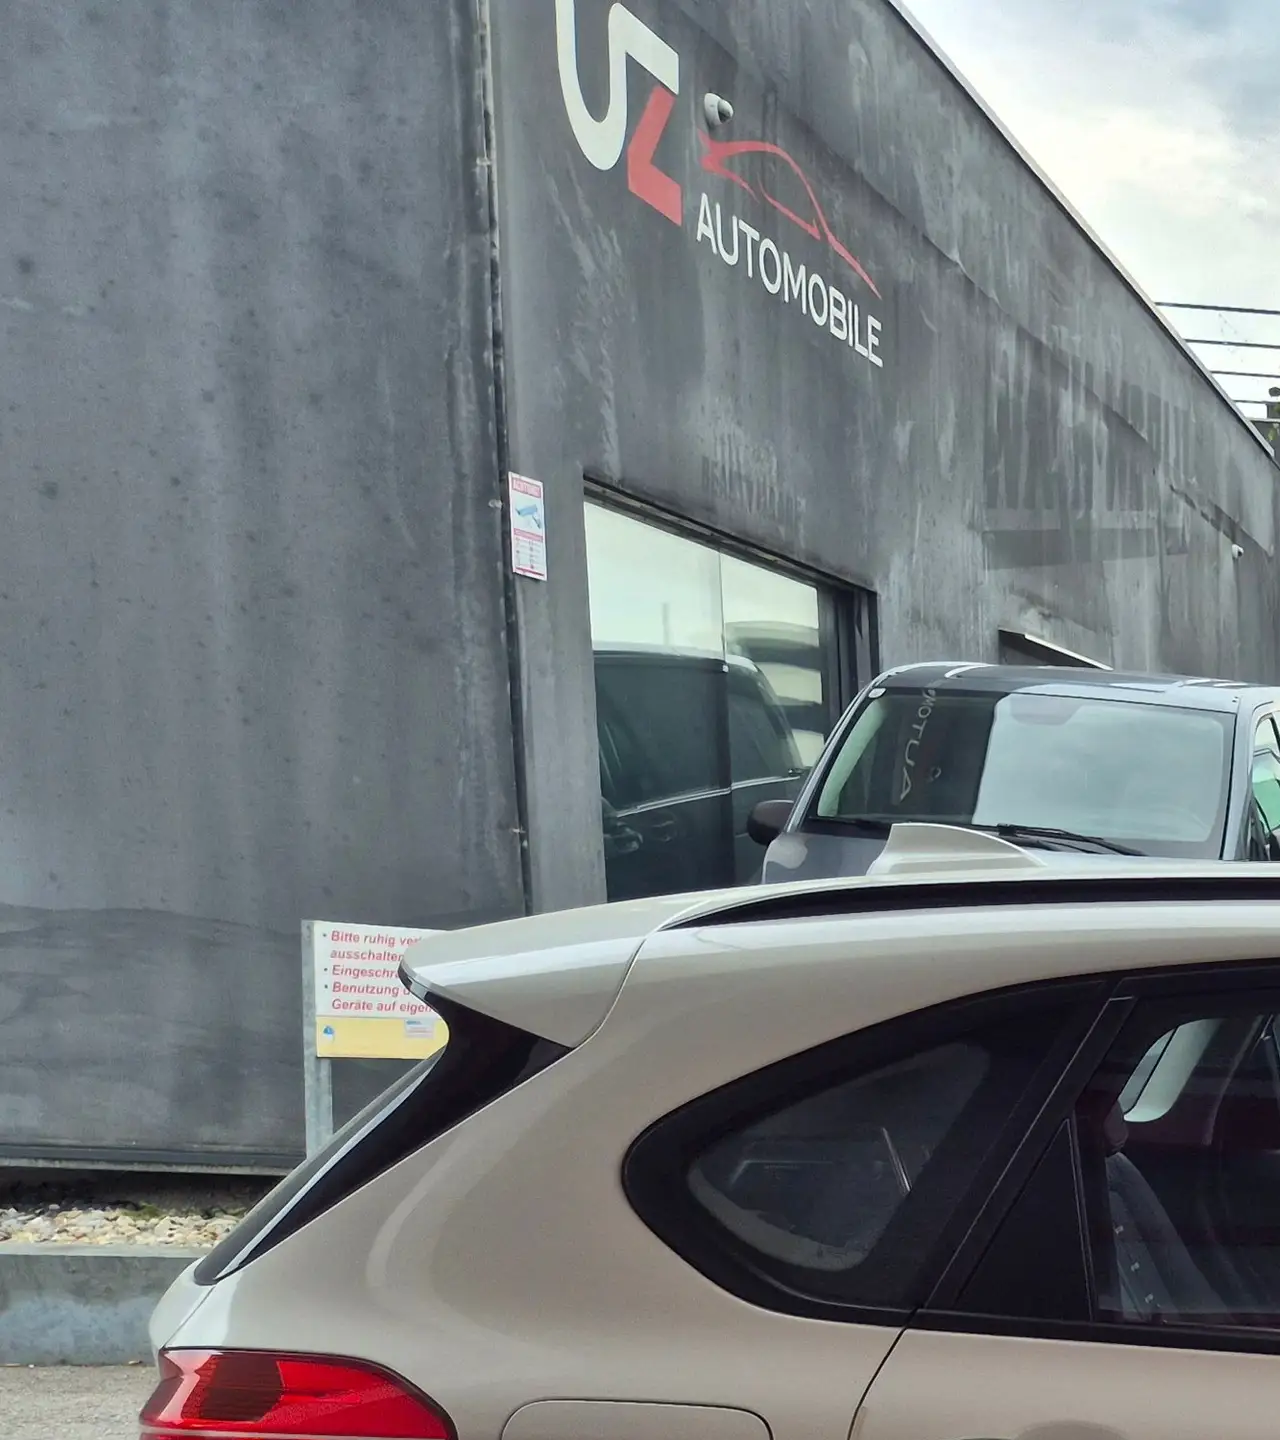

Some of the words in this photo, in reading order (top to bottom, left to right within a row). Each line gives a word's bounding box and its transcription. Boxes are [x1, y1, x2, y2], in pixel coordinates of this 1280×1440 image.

[696, 192, 883, 368] AUTOMOBILE
[331, 930, 360, 943] Bitte
[364, 933, 396, 947] ruhig
[332, 981, 400, 997] Benutzung
[332, 998, 373, 1010] Geräte
[376, 1001, 396, 1012] auf
